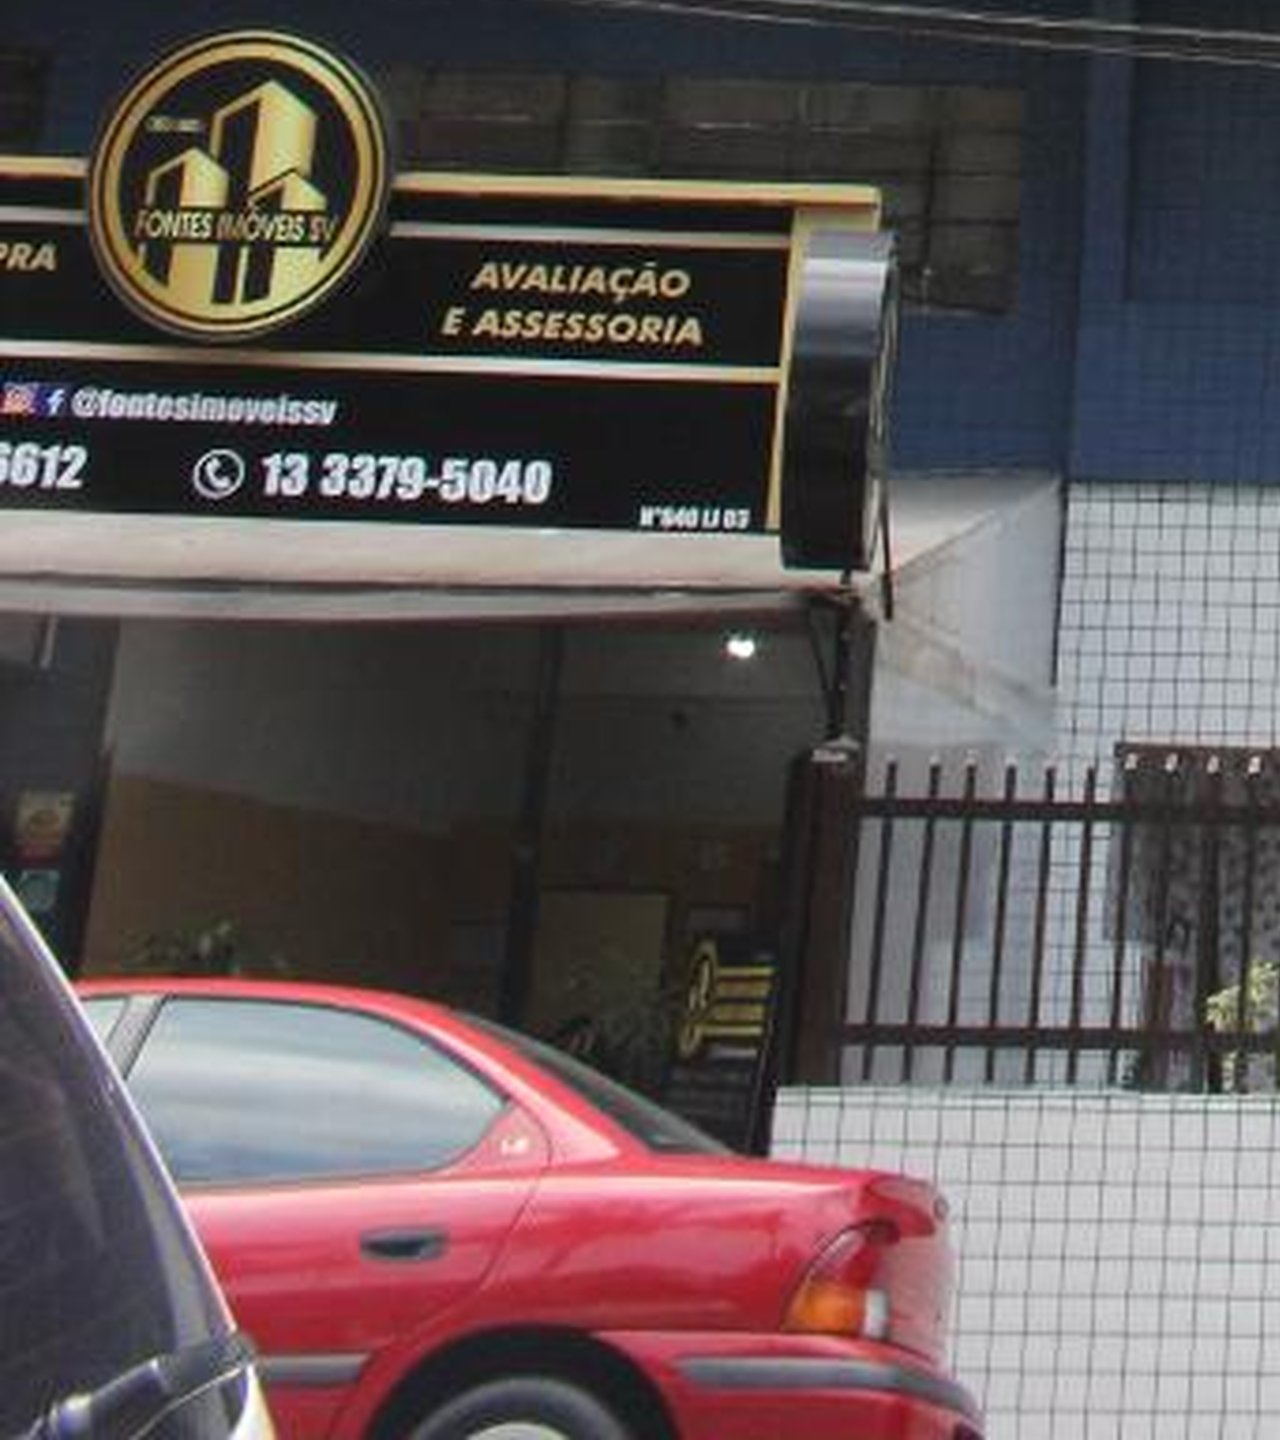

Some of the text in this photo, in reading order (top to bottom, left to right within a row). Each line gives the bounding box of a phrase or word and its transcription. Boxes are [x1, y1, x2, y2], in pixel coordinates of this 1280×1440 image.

[135, 210, 213, 239] FONTES
[217, 204, 305, 241] IMÓVEIS
[471, 262, 691, 304] AVALIAÇÃO
[441, 306, 704, 345] E ASSESSORIA
[71, 386, 339, 425] @fontesimoveissv
[262, 452, 553, 504] 13 3379-5040
